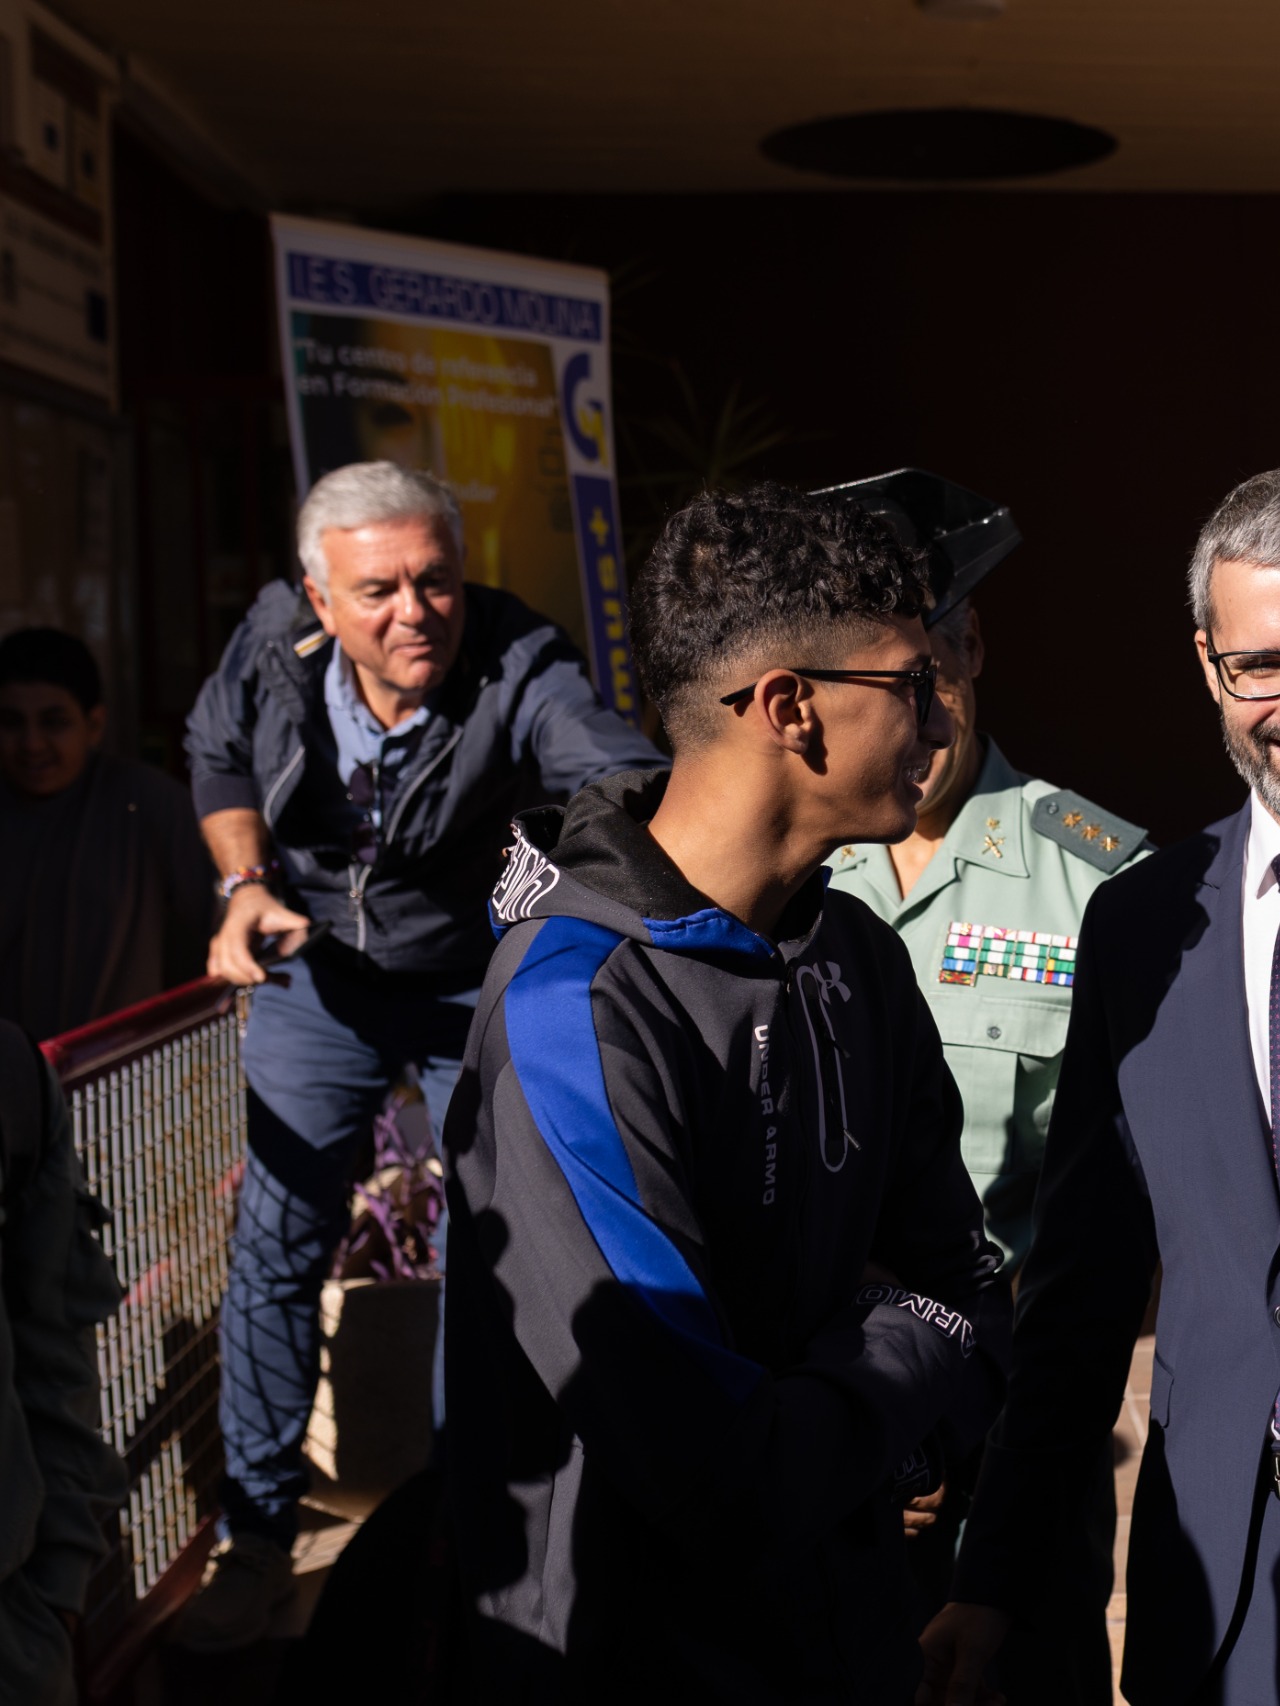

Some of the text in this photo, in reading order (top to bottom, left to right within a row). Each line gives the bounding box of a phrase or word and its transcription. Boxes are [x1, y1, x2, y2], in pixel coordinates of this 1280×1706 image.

[367, 266, 501, 325] GERARDO
[503, 288, 598, 338] MOLINA
[337, 342, 408, 373] centro
[754, 1024, 774, 1116] UNDER
